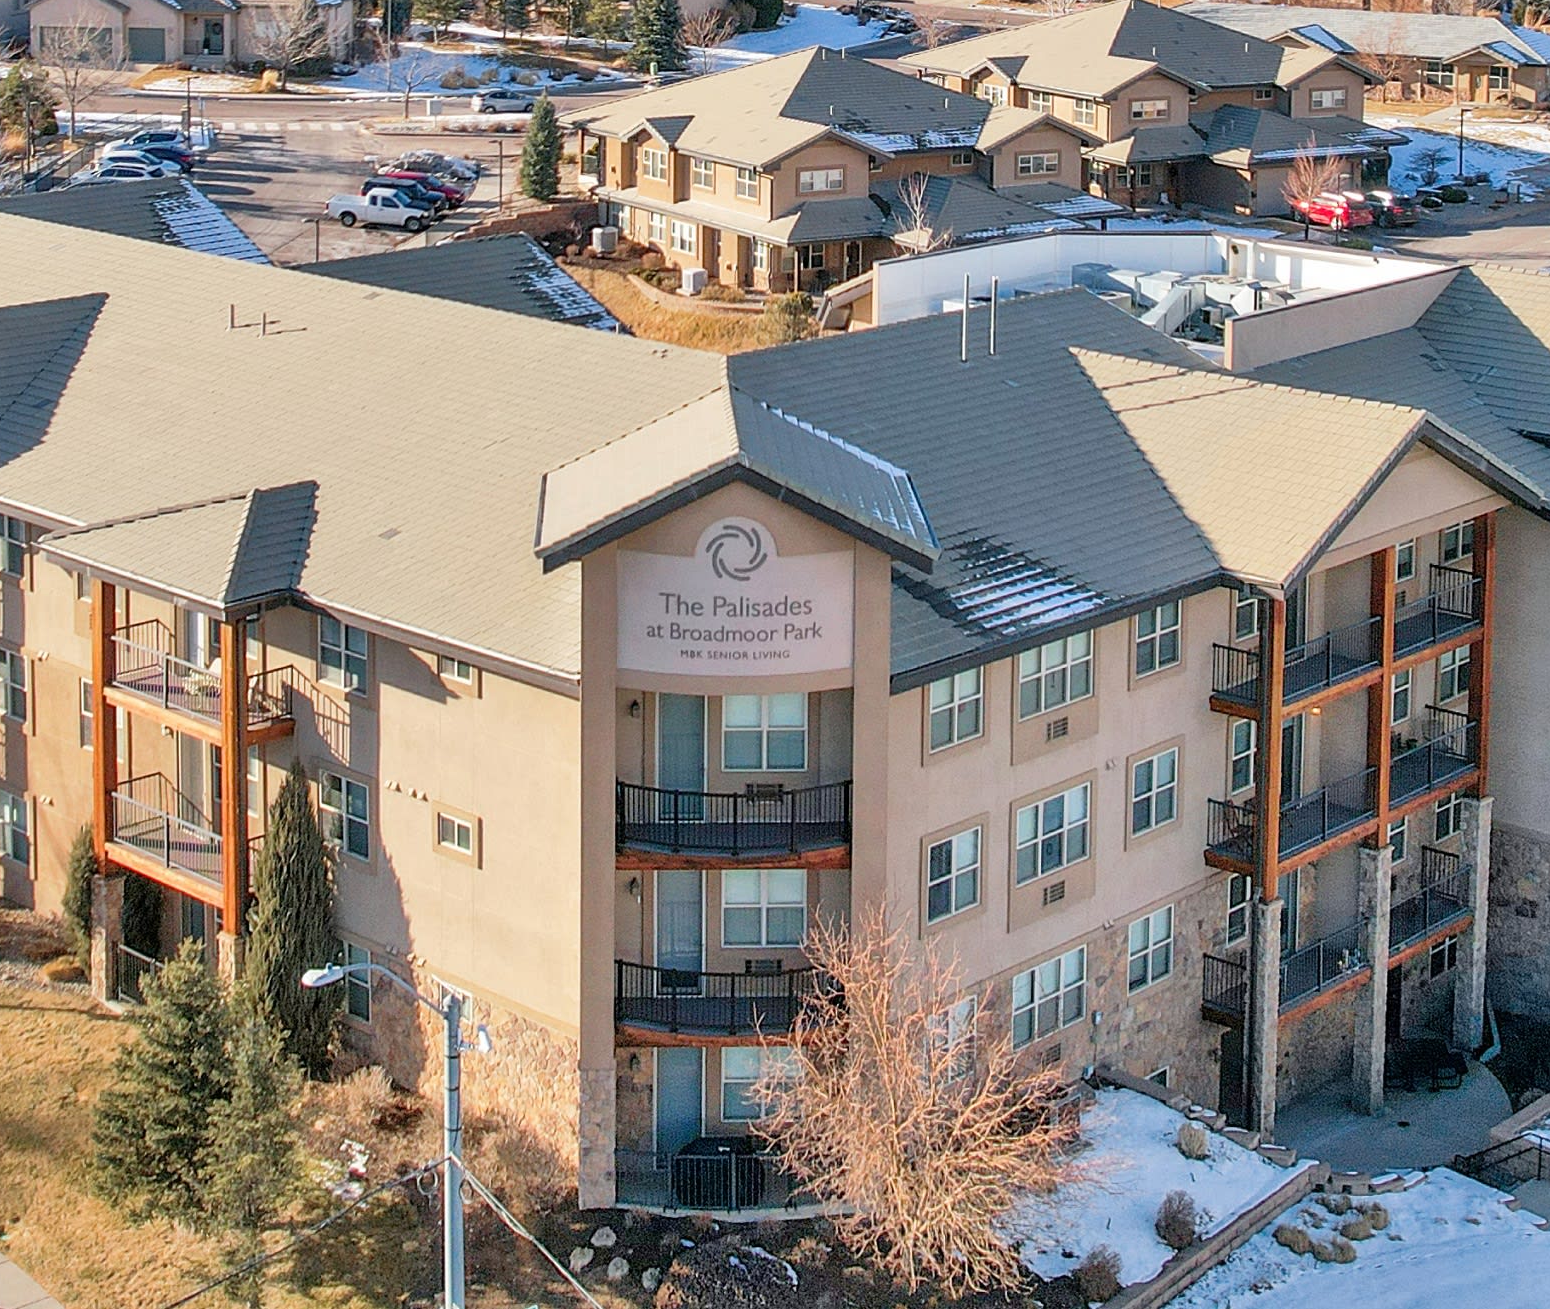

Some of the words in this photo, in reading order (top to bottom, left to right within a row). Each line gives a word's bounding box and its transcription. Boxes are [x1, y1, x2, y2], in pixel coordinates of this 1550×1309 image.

[659, 593, 704, 617] The
[712, 595, 813, 618] Palisades
[646, 623, 664, 638] at
[669, 622, 777, 642] Broadmoor
[783, 621, 823, 640] Park
[680, 649, 703, 659] MBK
[707, 650, 748, 660] SENIOR
[753, 649, 790, 660] LIVING
